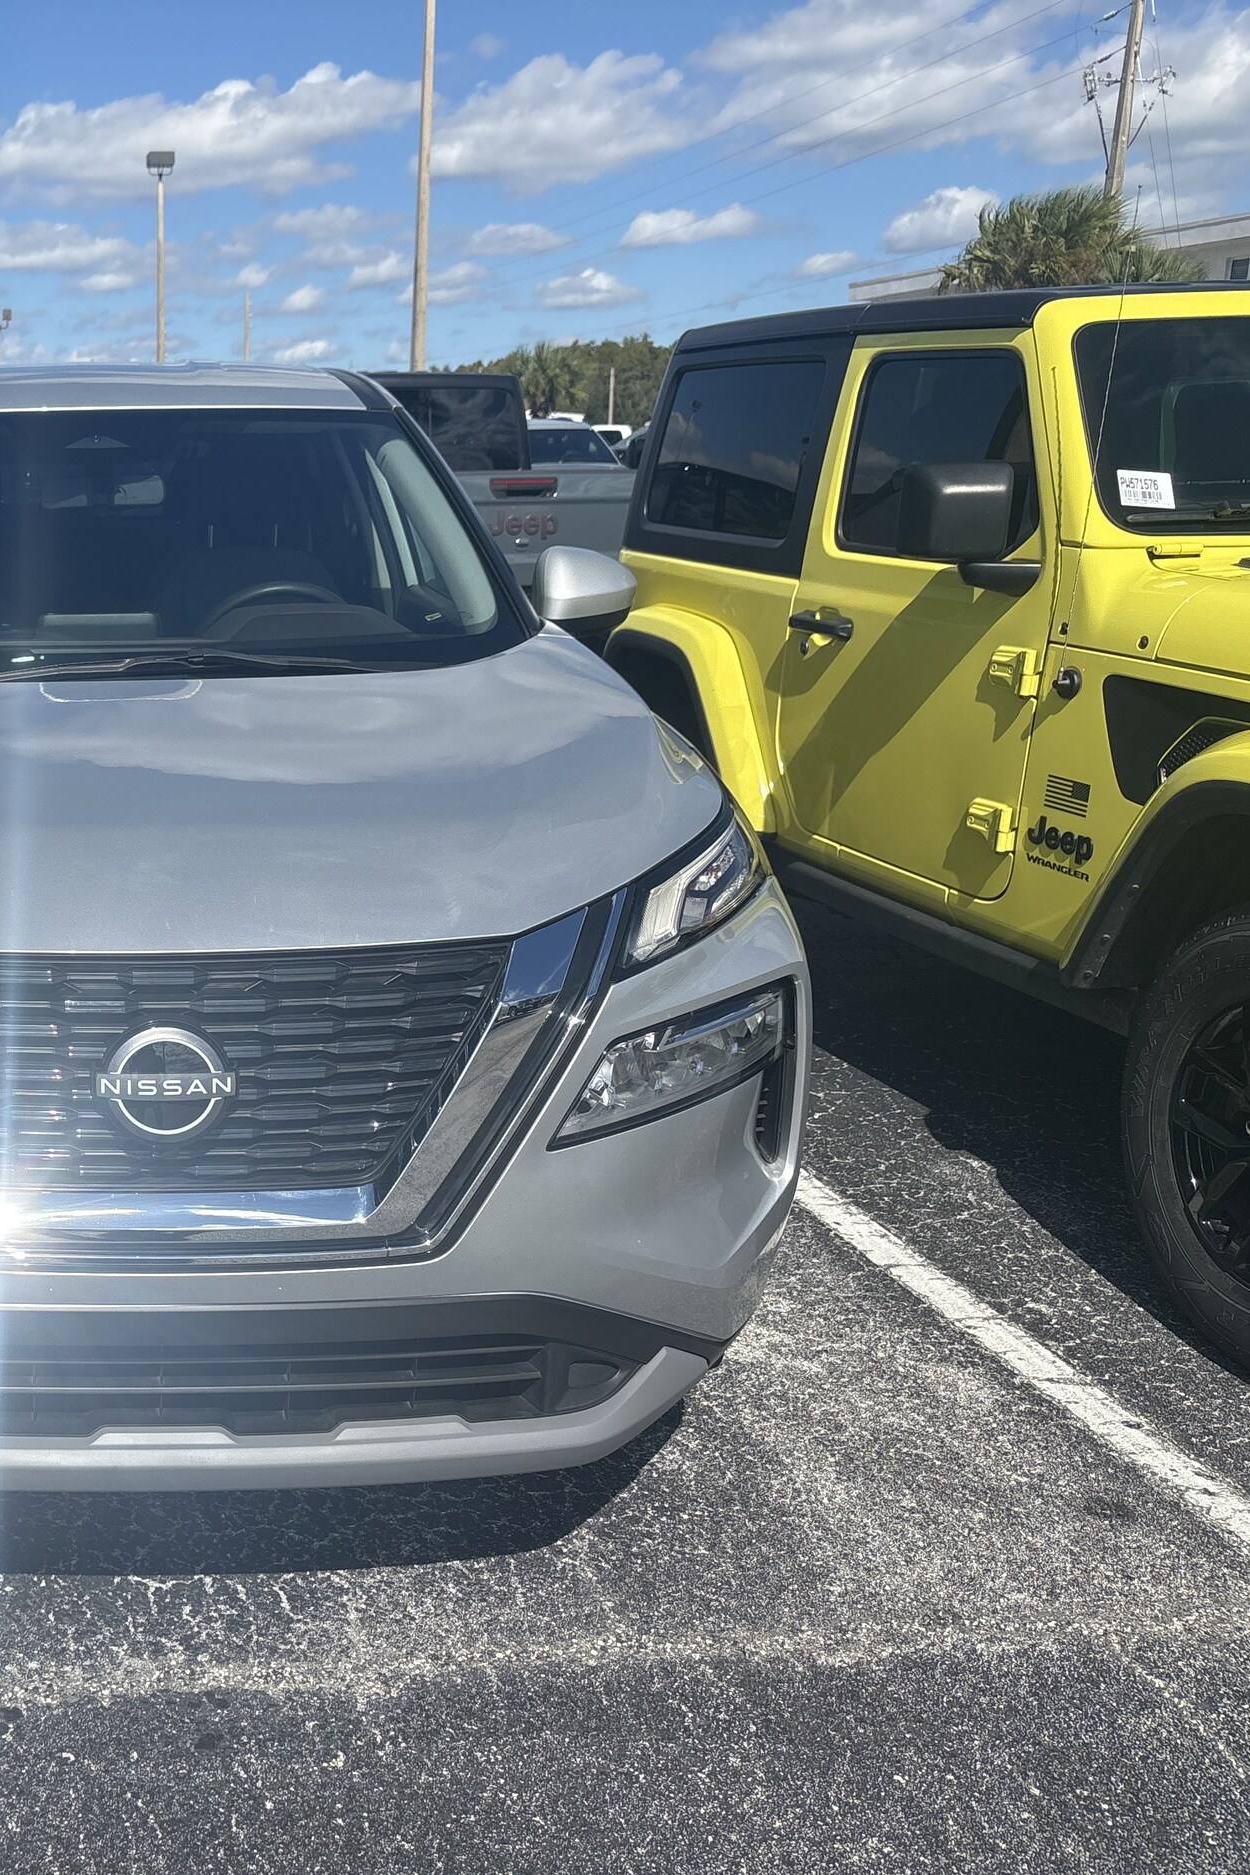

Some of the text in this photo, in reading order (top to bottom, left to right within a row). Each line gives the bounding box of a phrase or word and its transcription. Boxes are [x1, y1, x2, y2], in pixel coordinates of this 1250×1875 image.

[1120, 476, 1159, 491] PW571576
[486, 509, 558, 541] Jeep
[1027, 815, 1094, 866] Jeep
[1026, 852, 1090, 883] WRANGLER
[100, 1076, 232, 1097] NISSAN
